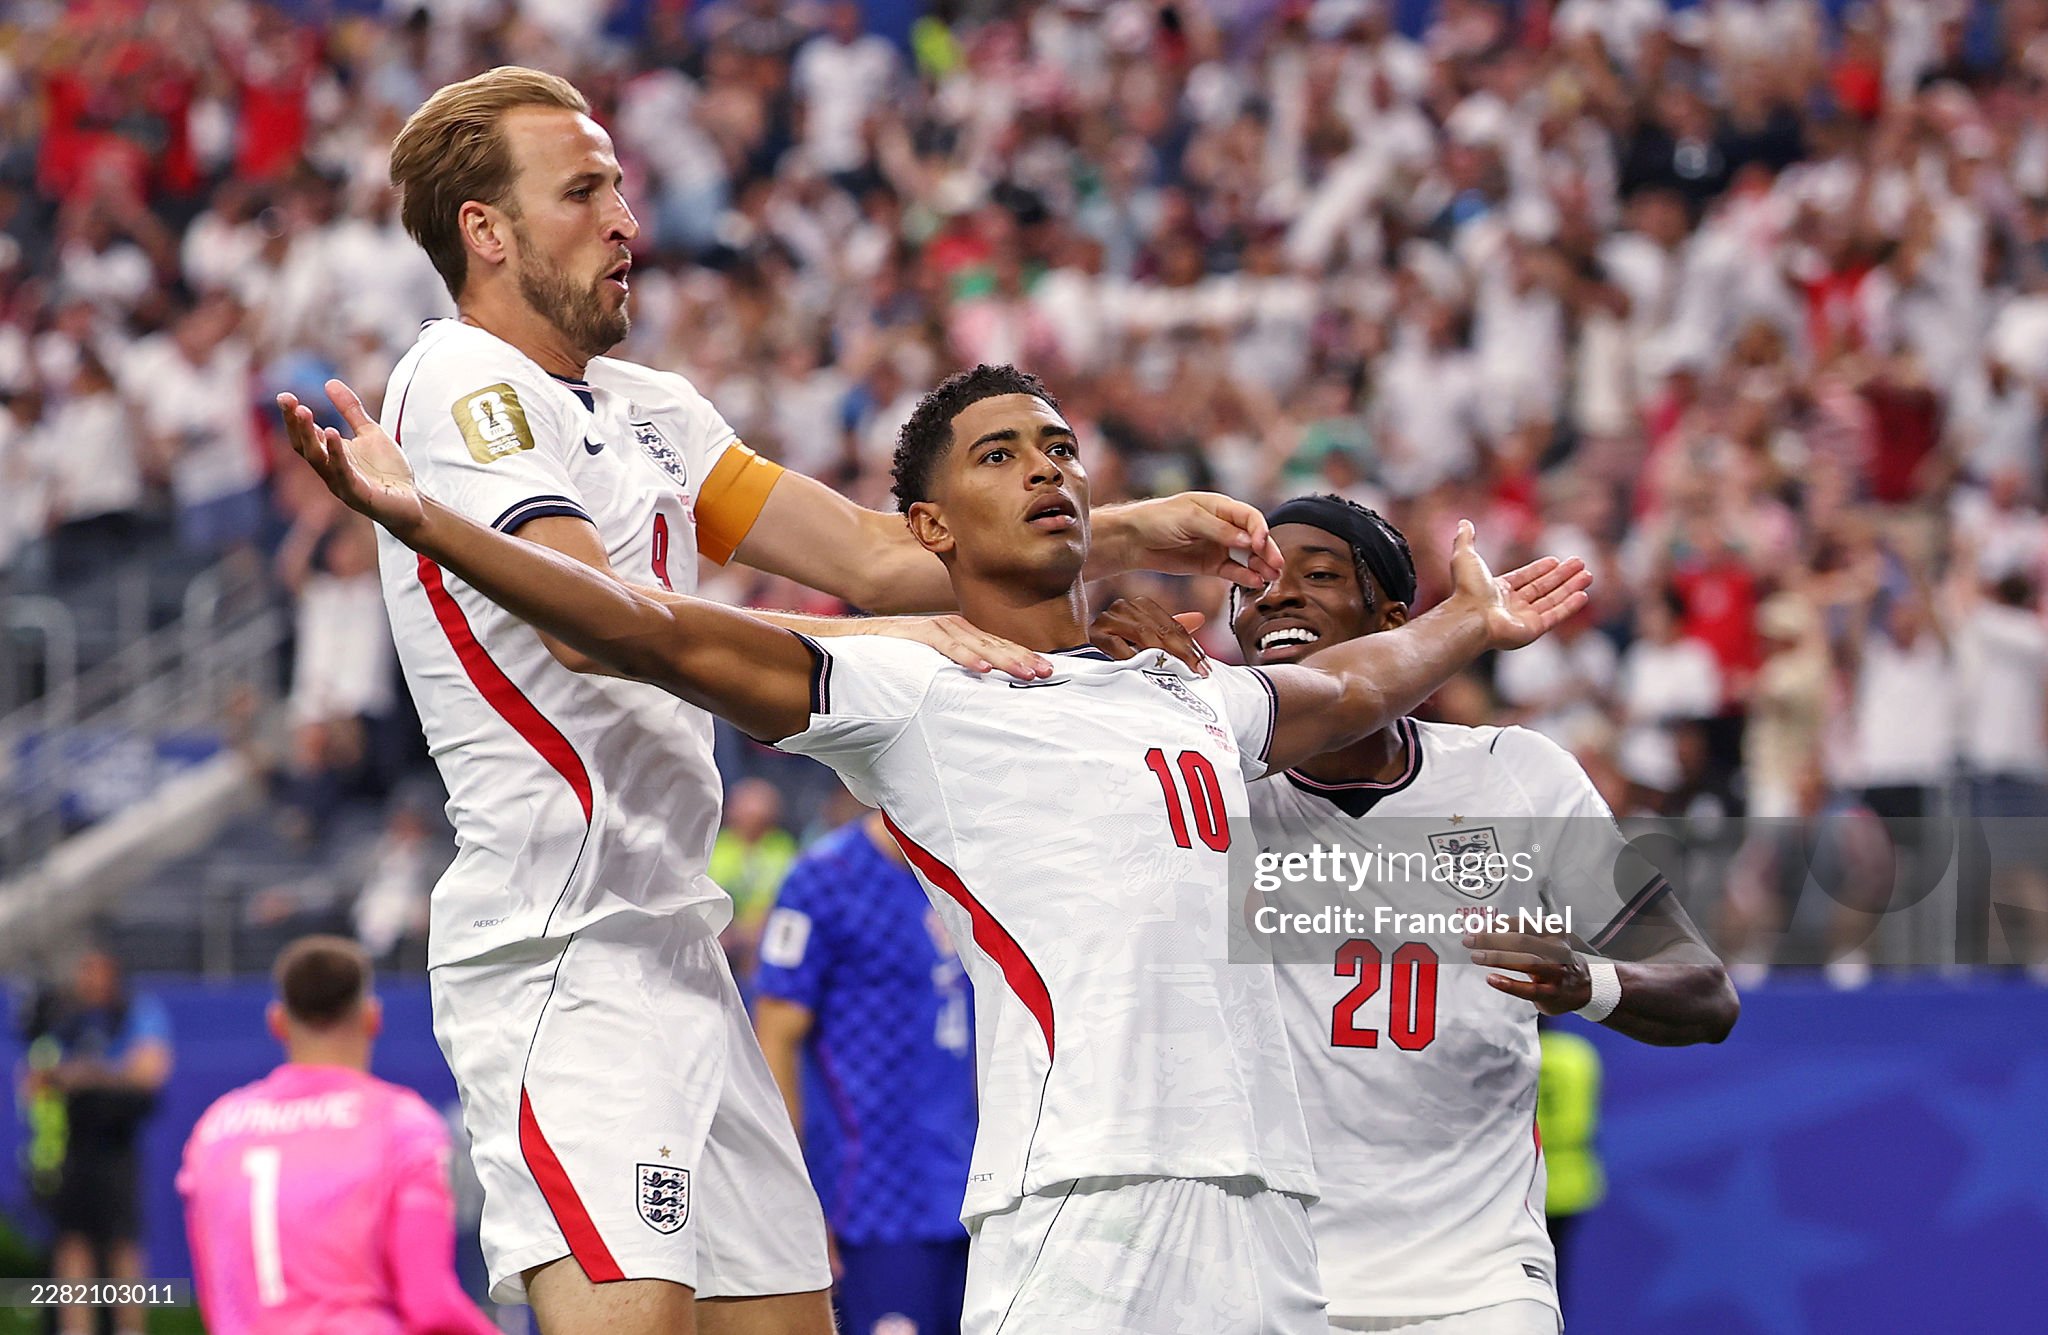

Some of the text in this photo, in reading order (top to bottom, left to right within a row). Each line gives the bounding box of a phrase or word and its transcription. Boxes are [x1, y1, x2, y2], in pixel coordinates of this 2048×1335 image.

[651, 512, 675, 593] 9
[1144, 747, 1233, 854] 10
[1330, 938, 1439, 1052] 20
[241, 1145, 288, 1308] 1
